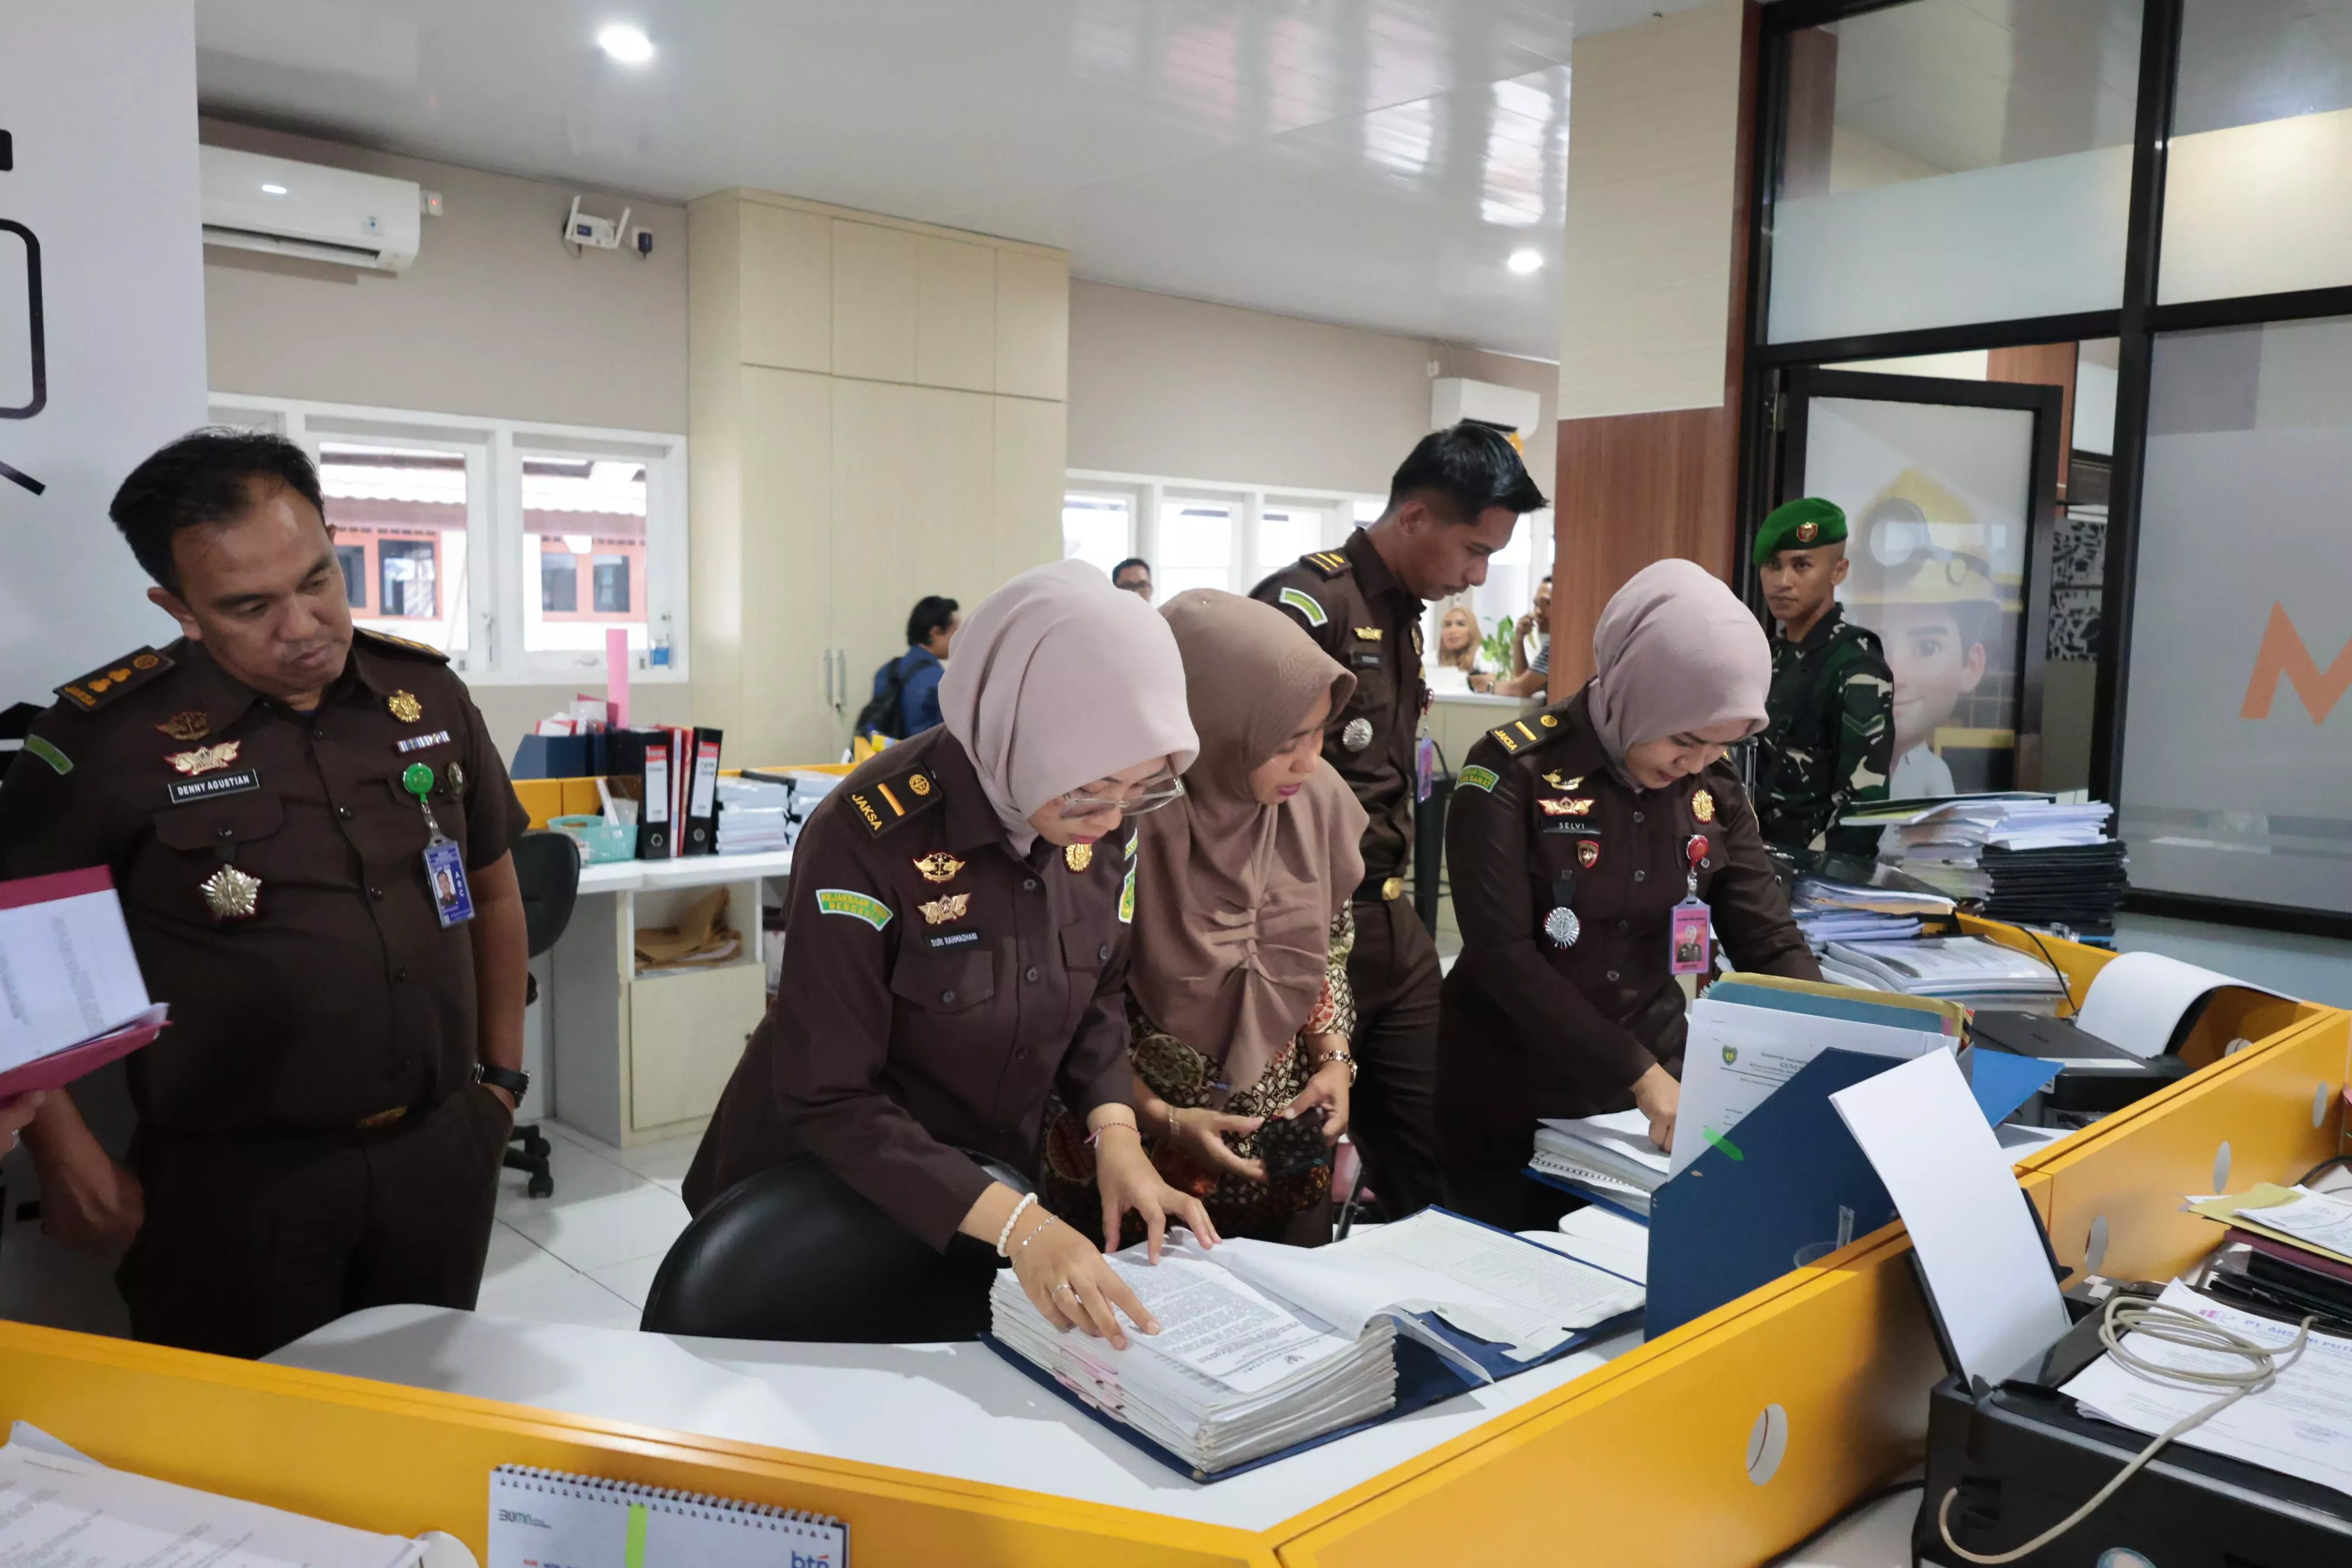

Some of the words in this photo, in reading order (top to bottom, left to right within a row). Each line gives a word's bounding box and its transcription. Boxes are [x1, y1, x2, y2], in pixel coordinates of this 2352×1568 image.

[1494, 730, 1517, 751] JAKSA
[177, 783, 205, 796] DENNY
[207, 775, 250, 790] AGUSTIAN
[851, 794, 882, 831] JAKSA
[821, 893, 870, 907] KEJAKSAAN
[930, 937, 945, 947] SURI
[945, 932, 978, 945] RAHMADHANI
